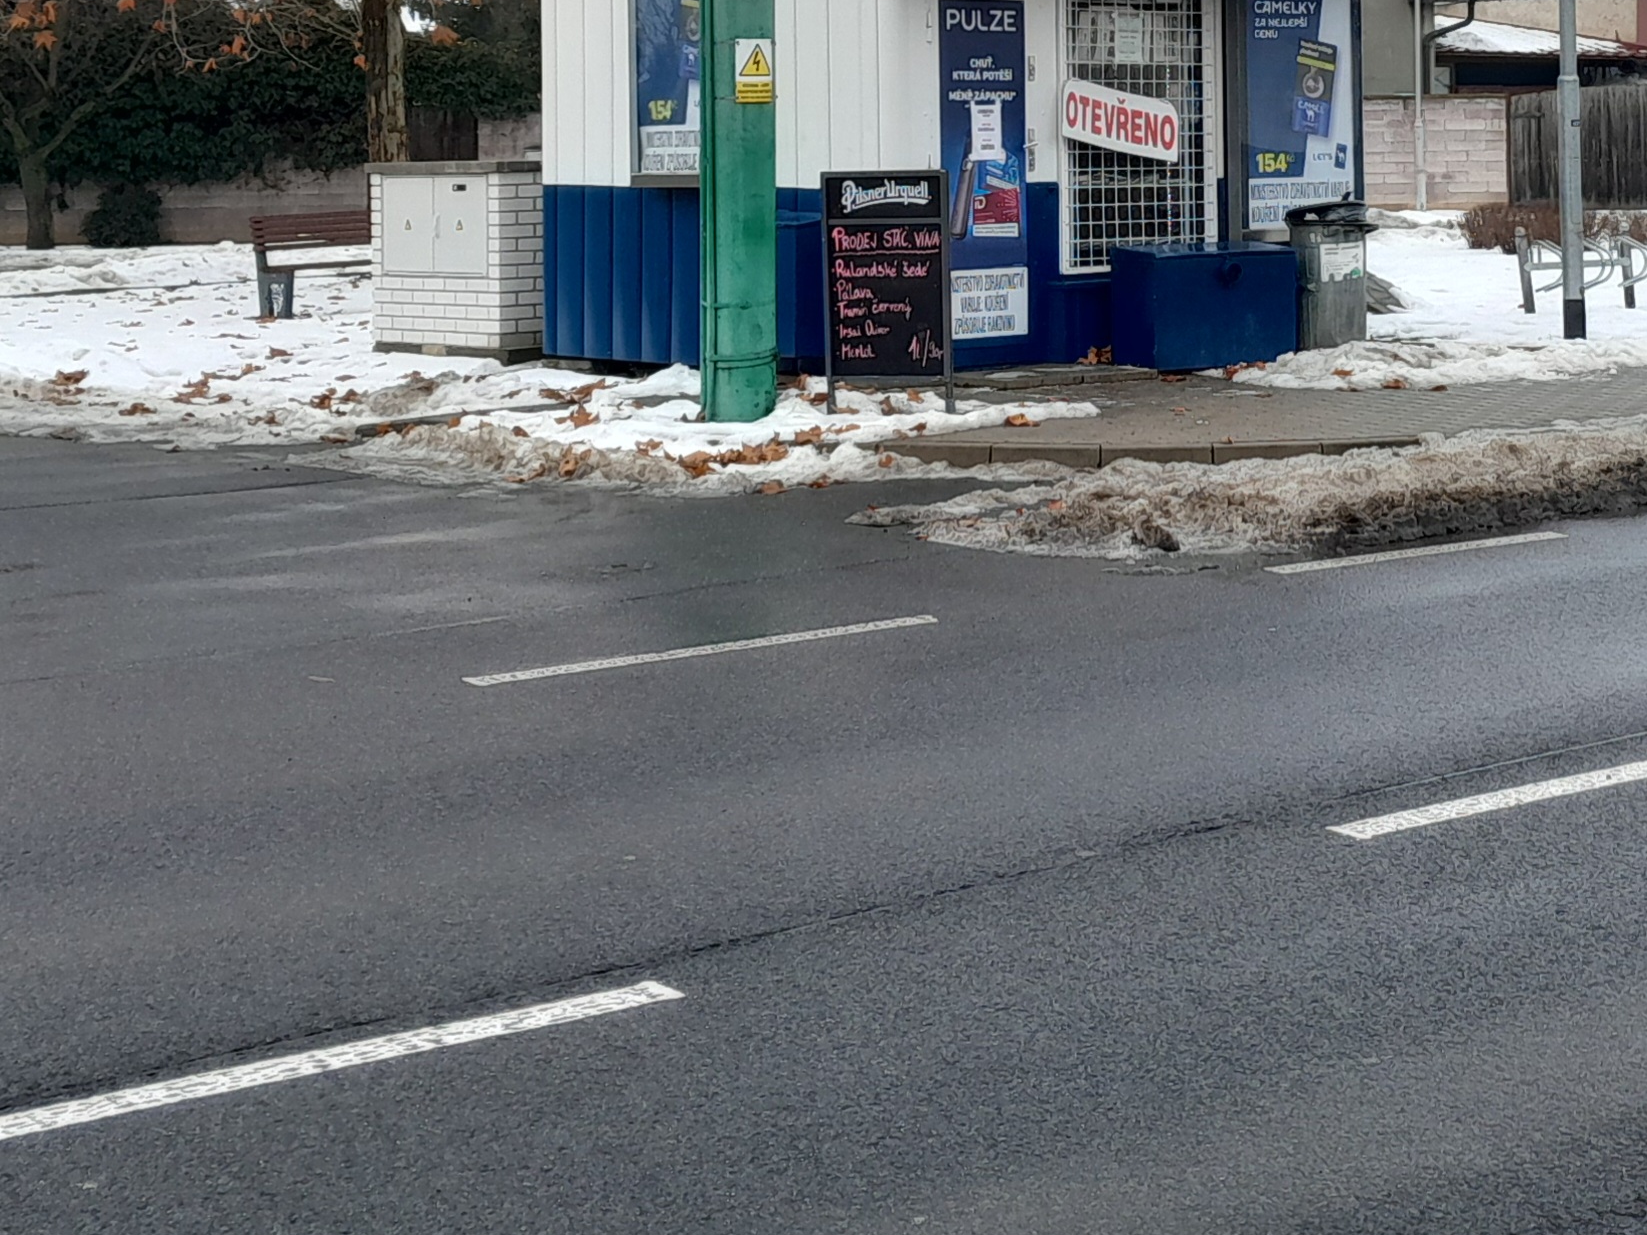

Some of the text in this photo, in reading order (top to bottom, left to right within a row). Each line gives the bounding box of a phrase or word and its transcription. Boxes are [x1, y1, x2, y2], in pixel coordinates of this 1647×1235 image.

[1254, 0, 1317, 15] CAMELKY
[946, 8, 1017, 32] PULZE
[1254, 16, 1308, 28] ZA NEJLEPŠÍ
[1254, 29, 1279, 39] CENU
[952, 69, 981, 81] KTERÁ
[648, 99, 672, 121] 154
[1066, 91, 1176, 151] OTEVŘENO
[1256, 152, 1288, 173] 154
[841, 178, 929, 214] Pilsner Urquell
[832, 226, 878, 252] PRODEJ
[835, 258, 898, 278] Rulandské
